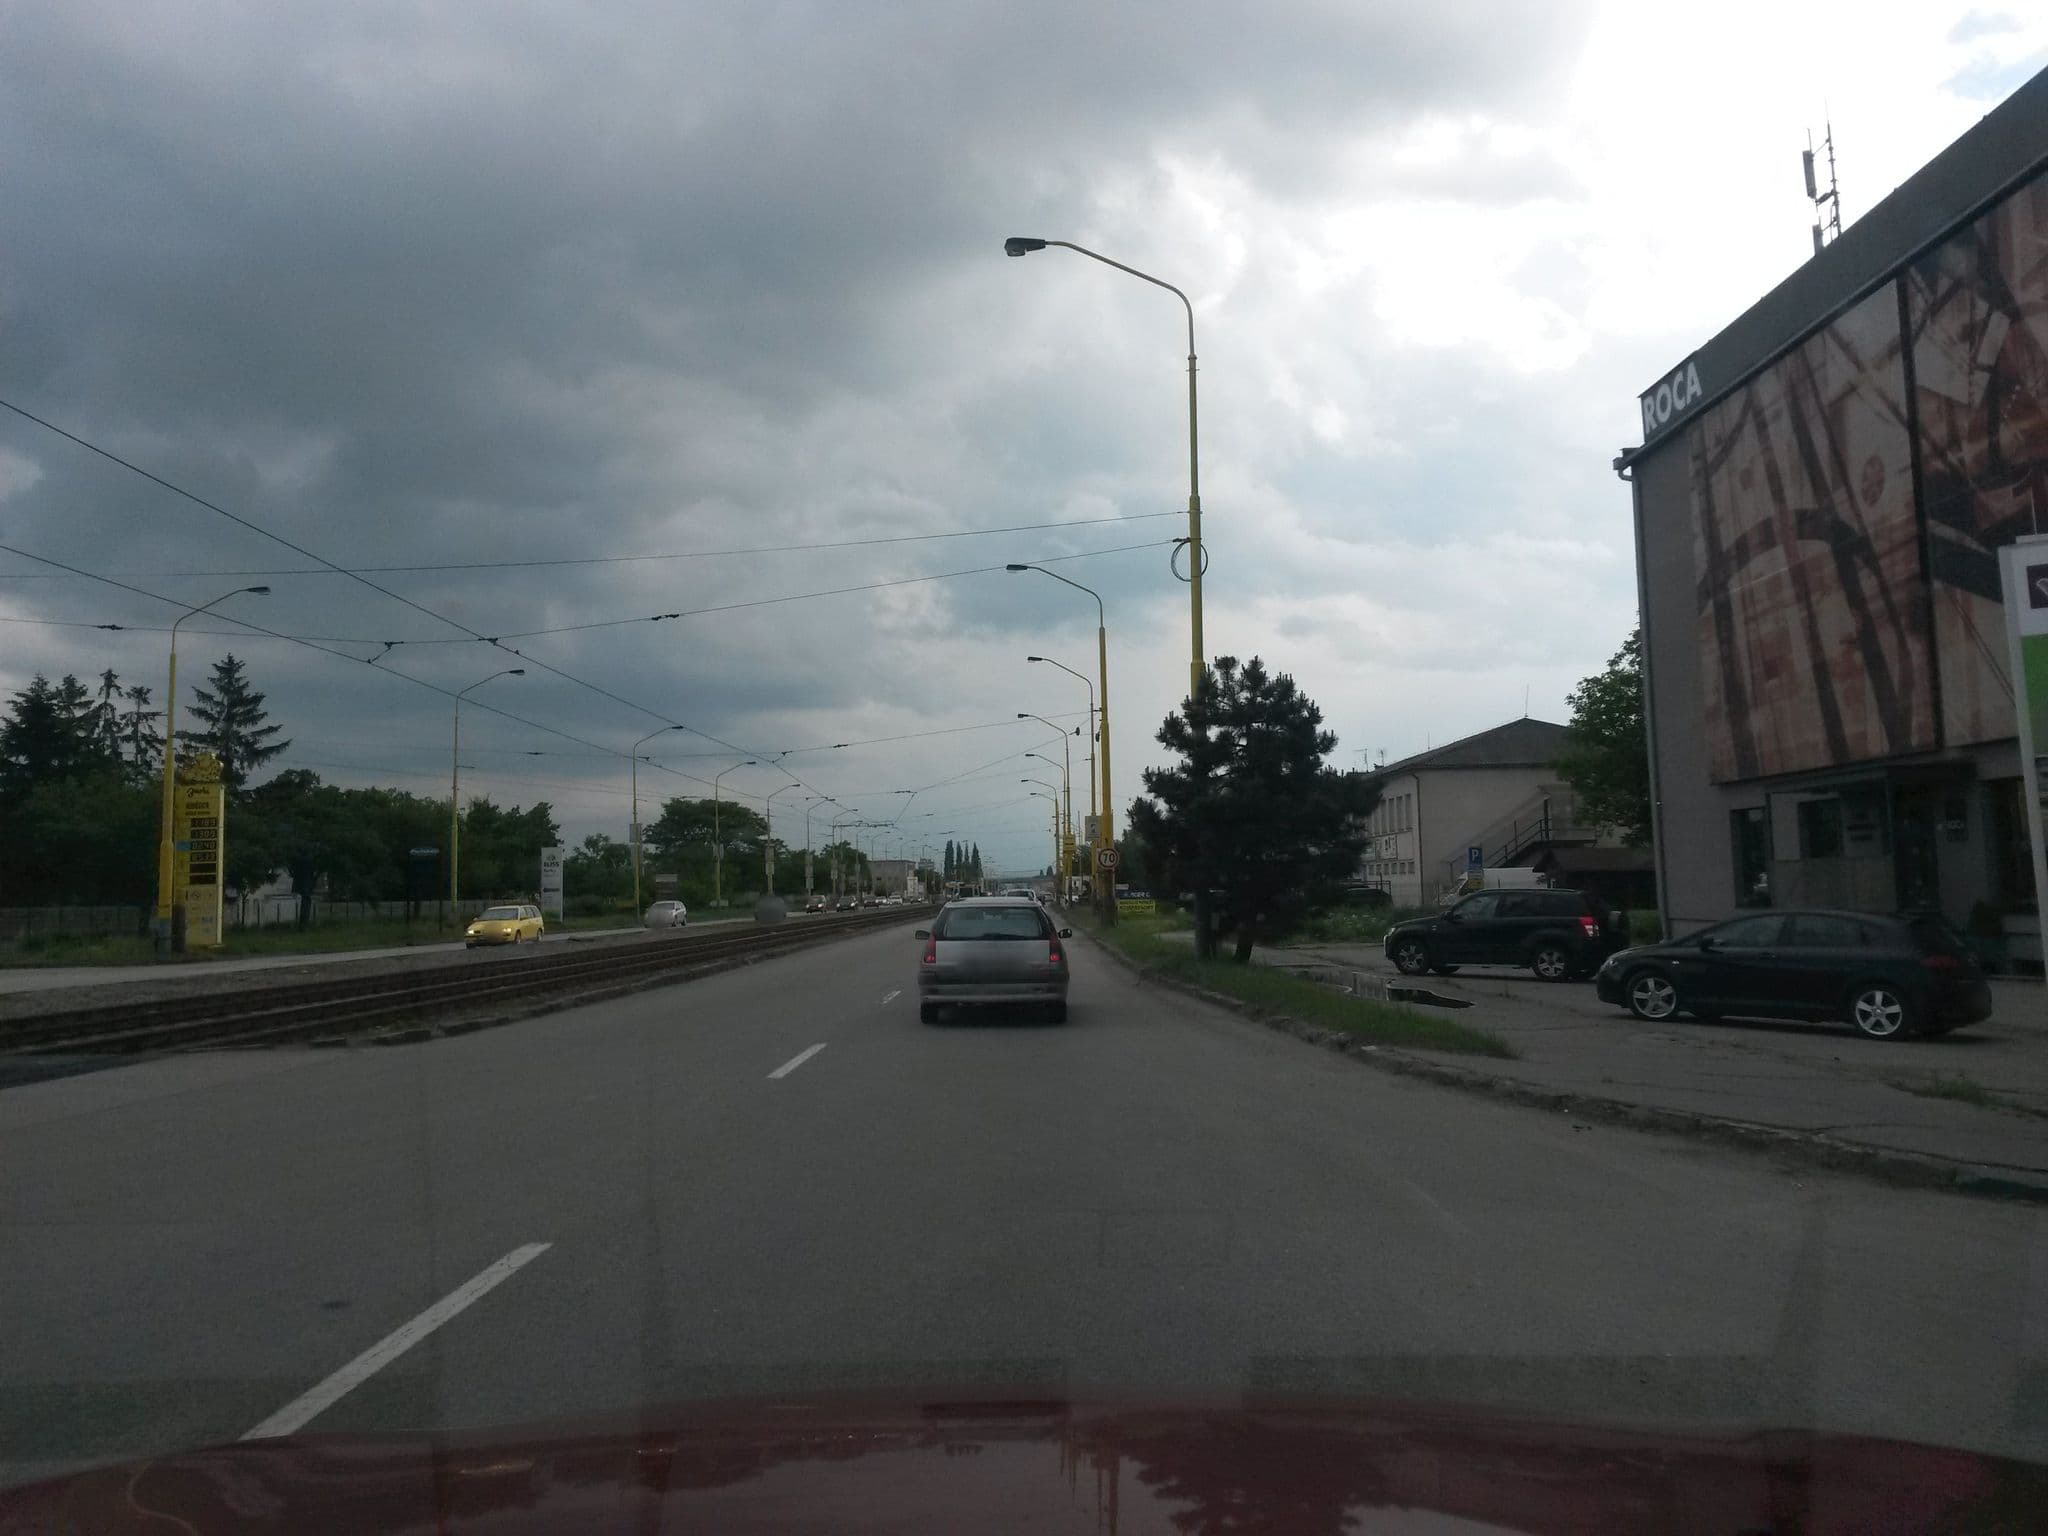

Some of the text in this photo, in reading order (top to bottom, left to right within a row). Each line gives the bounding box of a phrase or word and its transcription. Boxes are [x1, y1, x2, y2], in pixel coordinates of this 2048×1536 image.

[1643, 361, 1703, 434] ROCA
[1103, 853, 1116, 863] 70
[1471, 849, 1479, 861] P
